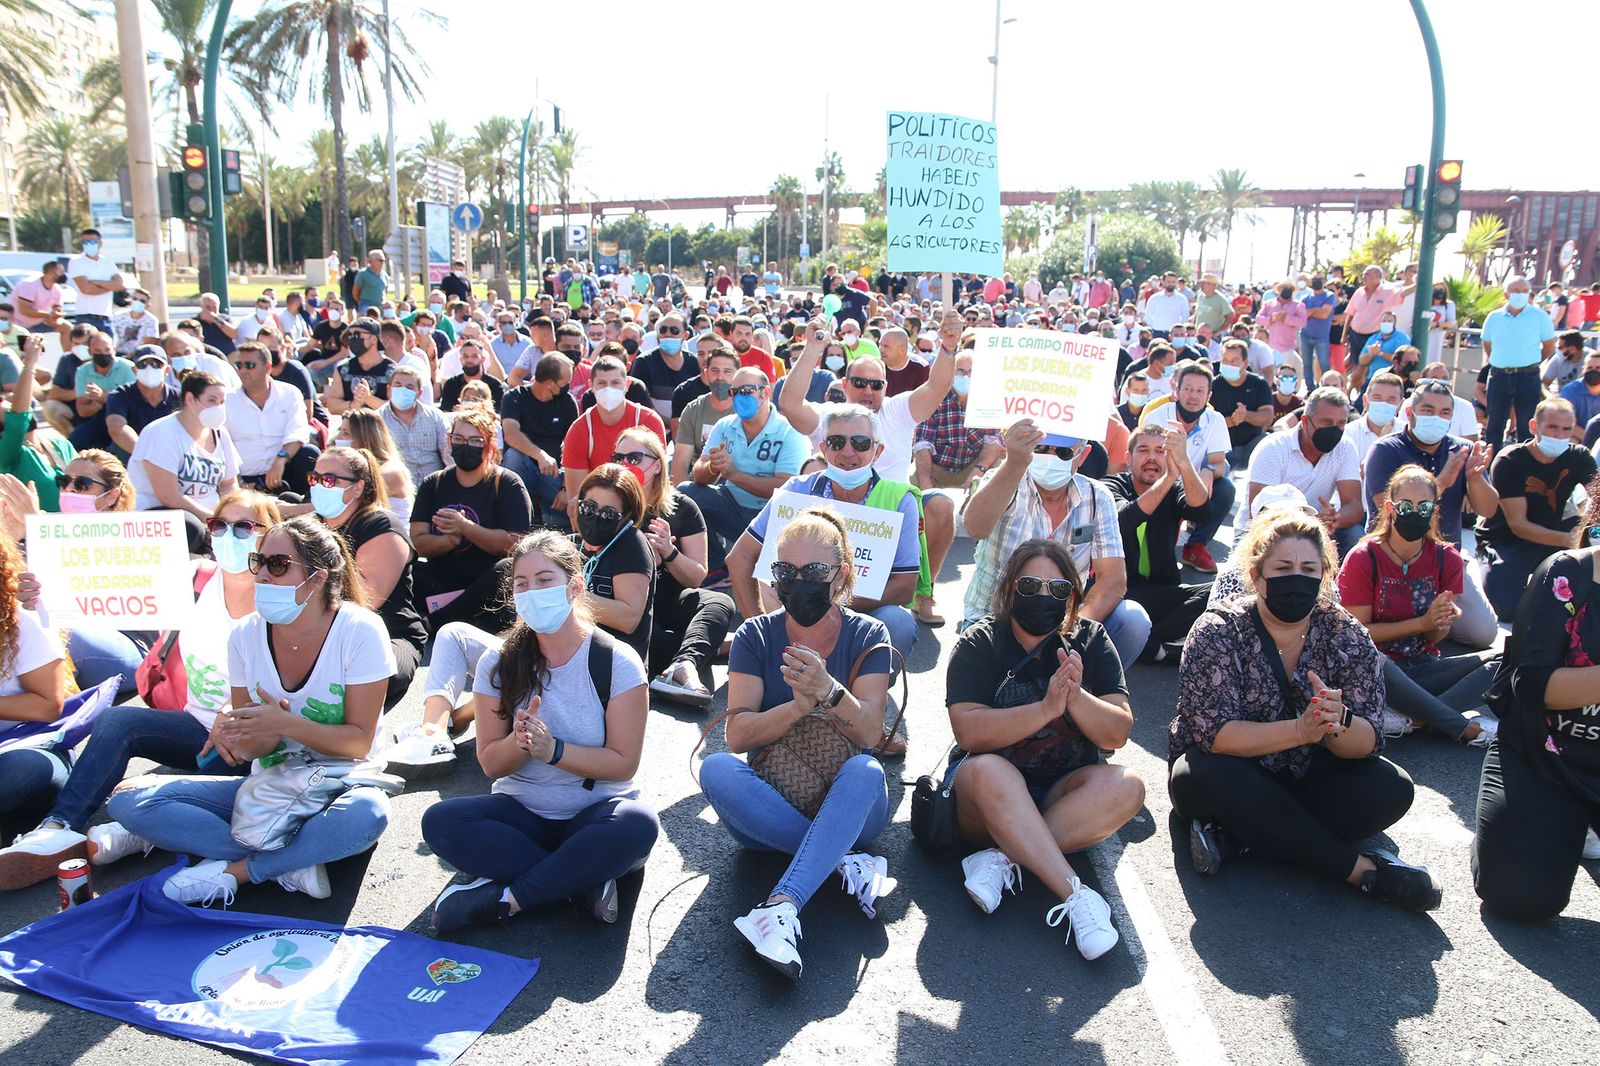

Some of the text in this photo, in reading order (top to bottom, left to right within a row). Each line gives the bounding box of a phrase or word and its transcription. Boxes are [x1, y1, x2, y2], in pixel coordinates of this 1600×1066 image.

[888, 141, 997, 169] TRAIDORES
[922, 167, 980, 187] HABEIS
[918, 213, 976, 229] A LOS
[988, 336, 1107, 361] SI EL CAMPO MUERE
[1003, 355, 1093, 381] LOS PUEBLOS
[1004, 378, 1078, 399] QUEDARAN
[1004, 397, 1075, 422] VACIOS
[756, 440, 783, 463] 87
[777, 504, 794, 520] NO
[39, 521, 172, 539] SI EL CAMPO MUERE
[61, 545, 161, 567] LOS PUEBLOS
[854, 547, 873, 561] DEL
[854, 564, 870, 577] TE
[70, 574, 153, 590] QUEDARAN
[75, 595, 158, 616] VACIOS
